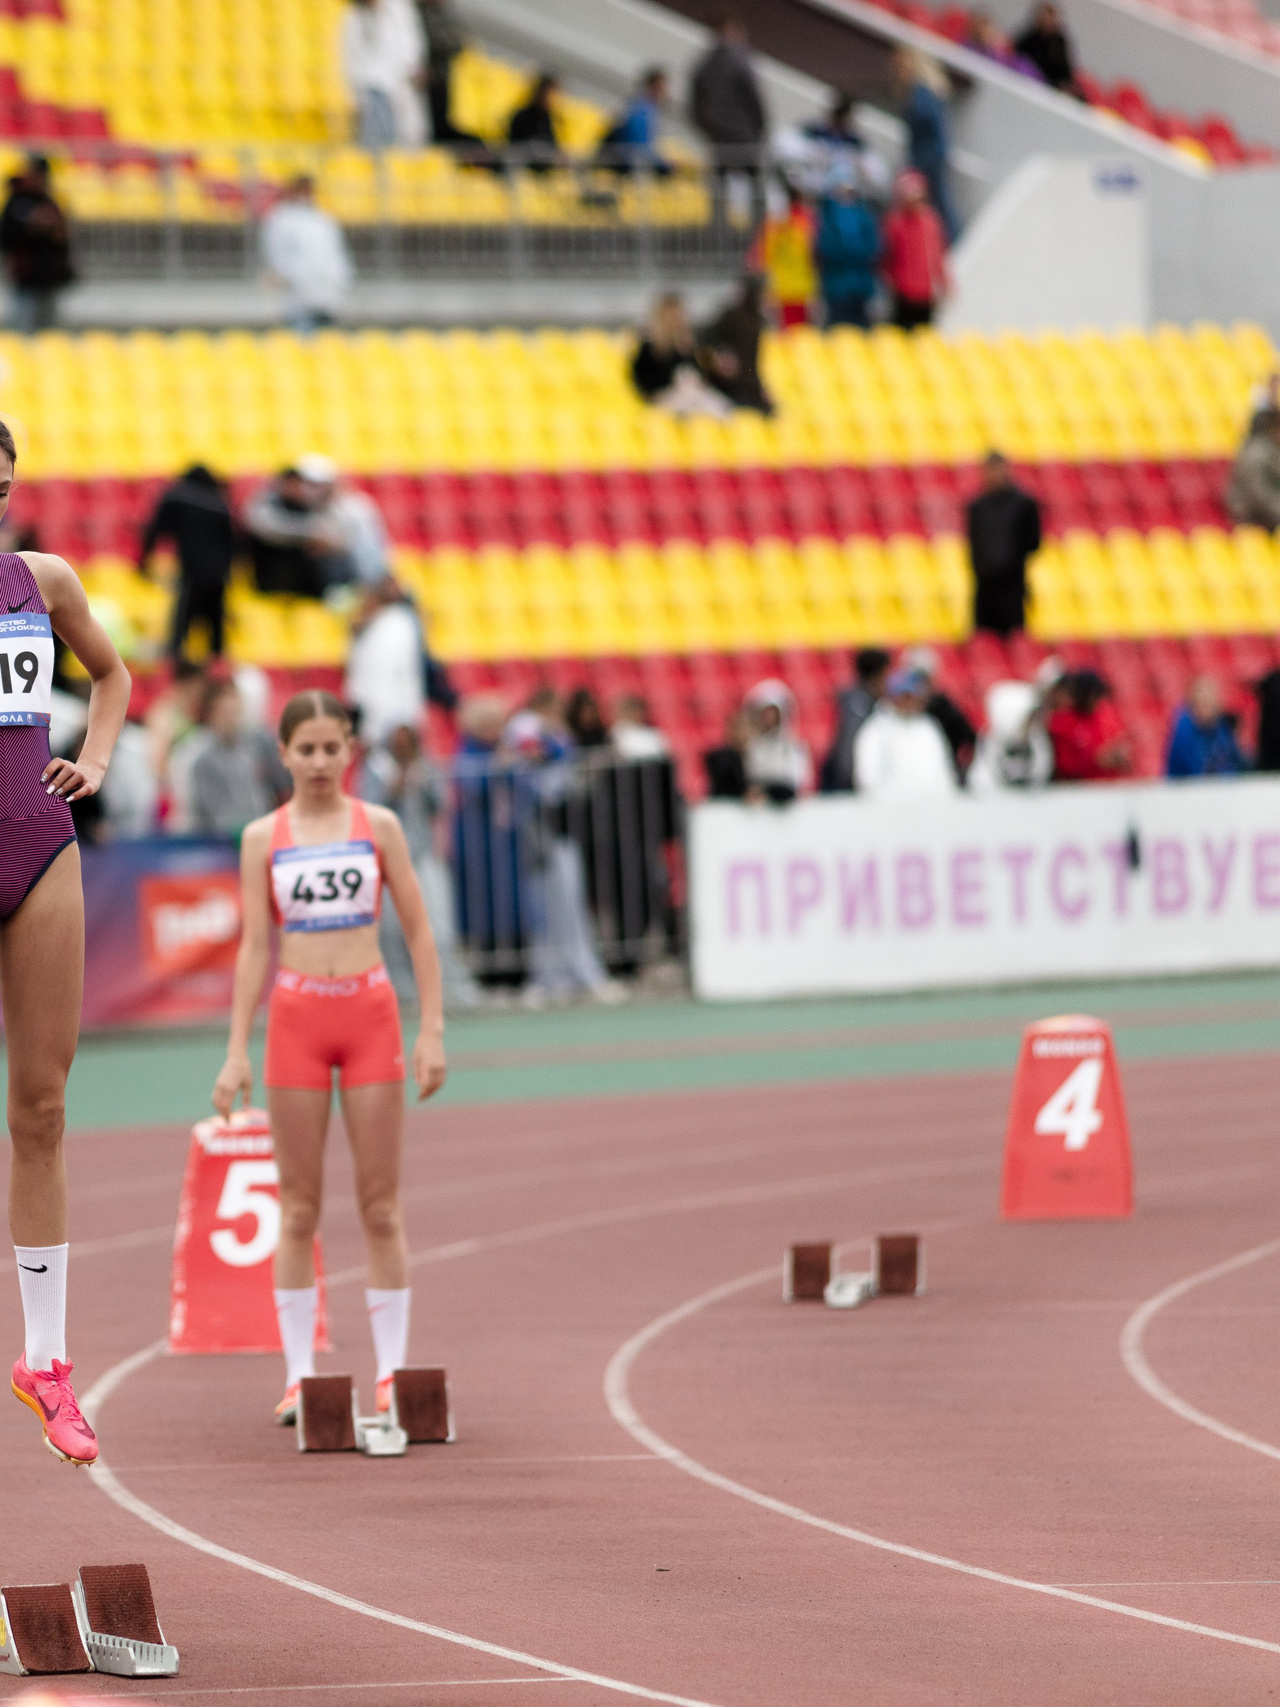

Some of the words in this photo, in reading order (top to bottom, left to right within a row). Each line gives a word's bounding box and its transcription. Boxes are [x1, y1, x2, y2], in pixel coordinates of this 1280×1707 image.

[291, 868, 363, 904] 439
[1033, 1057, 1104, 1151] 4
[209, 1160, 282, 1267] 5
